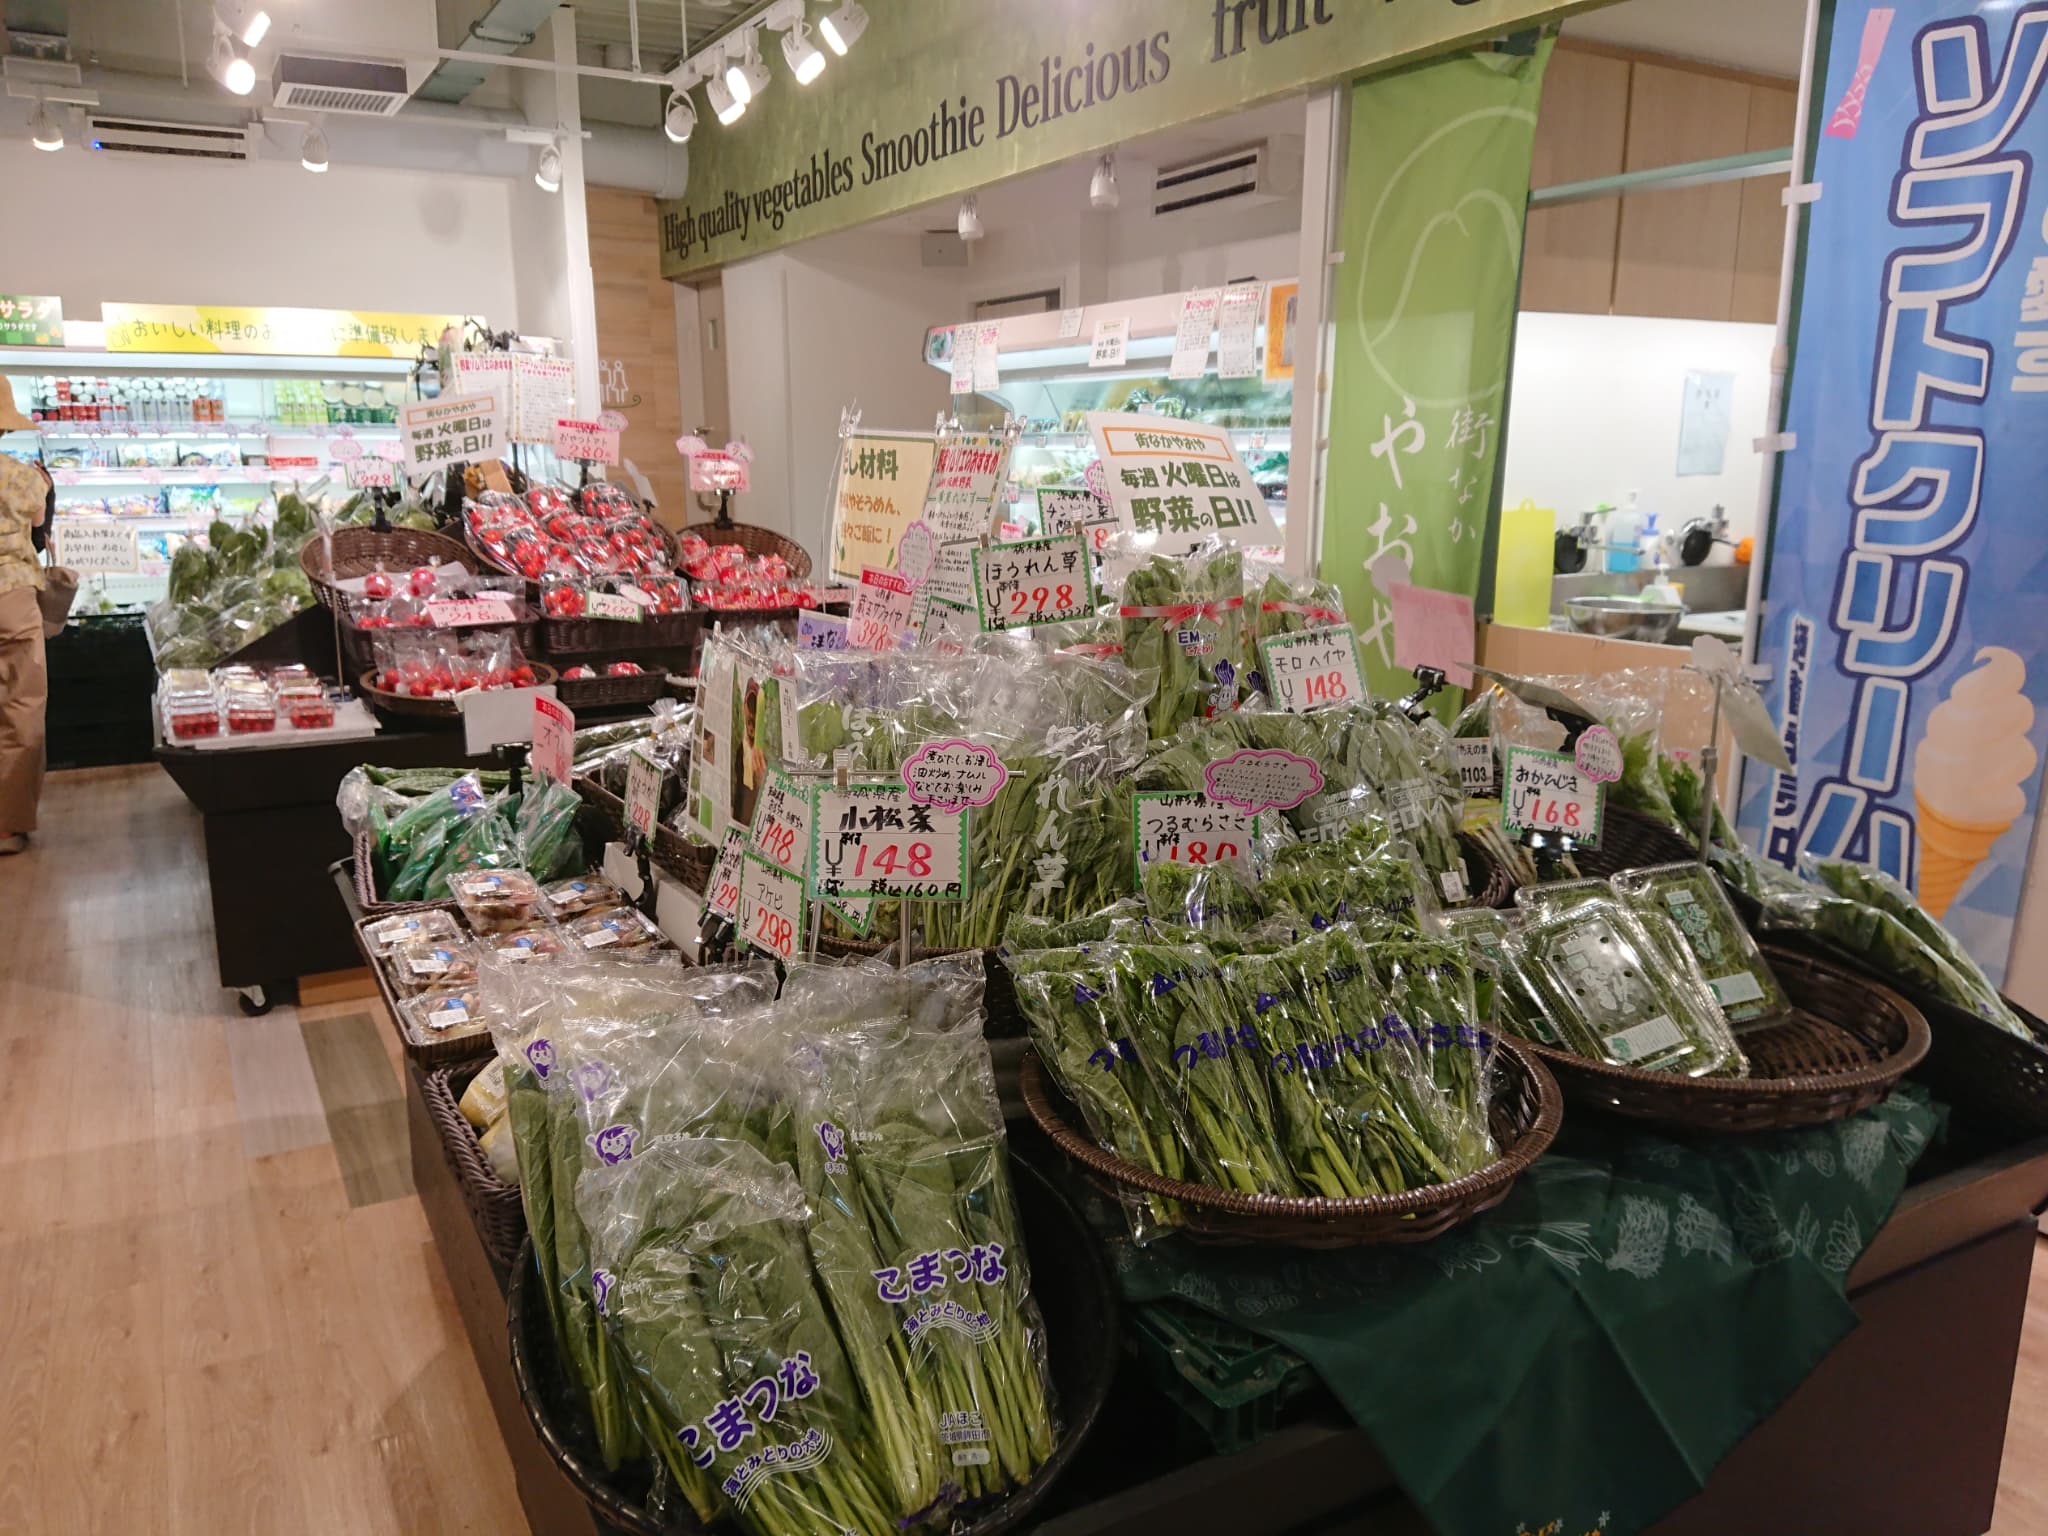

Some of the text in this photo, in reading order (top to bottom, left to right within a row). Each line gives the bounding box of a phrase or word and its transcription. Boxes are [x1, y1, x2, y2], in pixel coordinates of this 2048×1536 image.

[664, 206, 697, 260] High
[698, 189, 752, 253] quality
[752, 148, 854, 231] vegetables
[861, 96, 985, 186] Smoothie
[995, 31, 1171, 139] Delicious
[1135, 432, 1206, 452] 街なかやおや
[1445, 404, 1495, 544] 街なか
[985, 550, 1079, 584] ほうれん草
[1009, 584, 1073, 615] 298
[1177, 630, 1201, 644] EM
[1275, 648, 1346, 673] モロヘイヤ
[1305, 671, 1347, 705] 148
[1515, 765, 1579, 793] おかひじき
[839, 804, 936, 833] 小松菜
[1531, 799, 1581, 827] 168
[761, 819, 795, 865] 148
[855, 842, 933, 877] 148
[757, 882, 783, 912] アケビ
[756, 906, 792, 957] 298
[870, 1241, 1008, 1304] こまつな
[677, 1350, 820, 1470] こまつな
